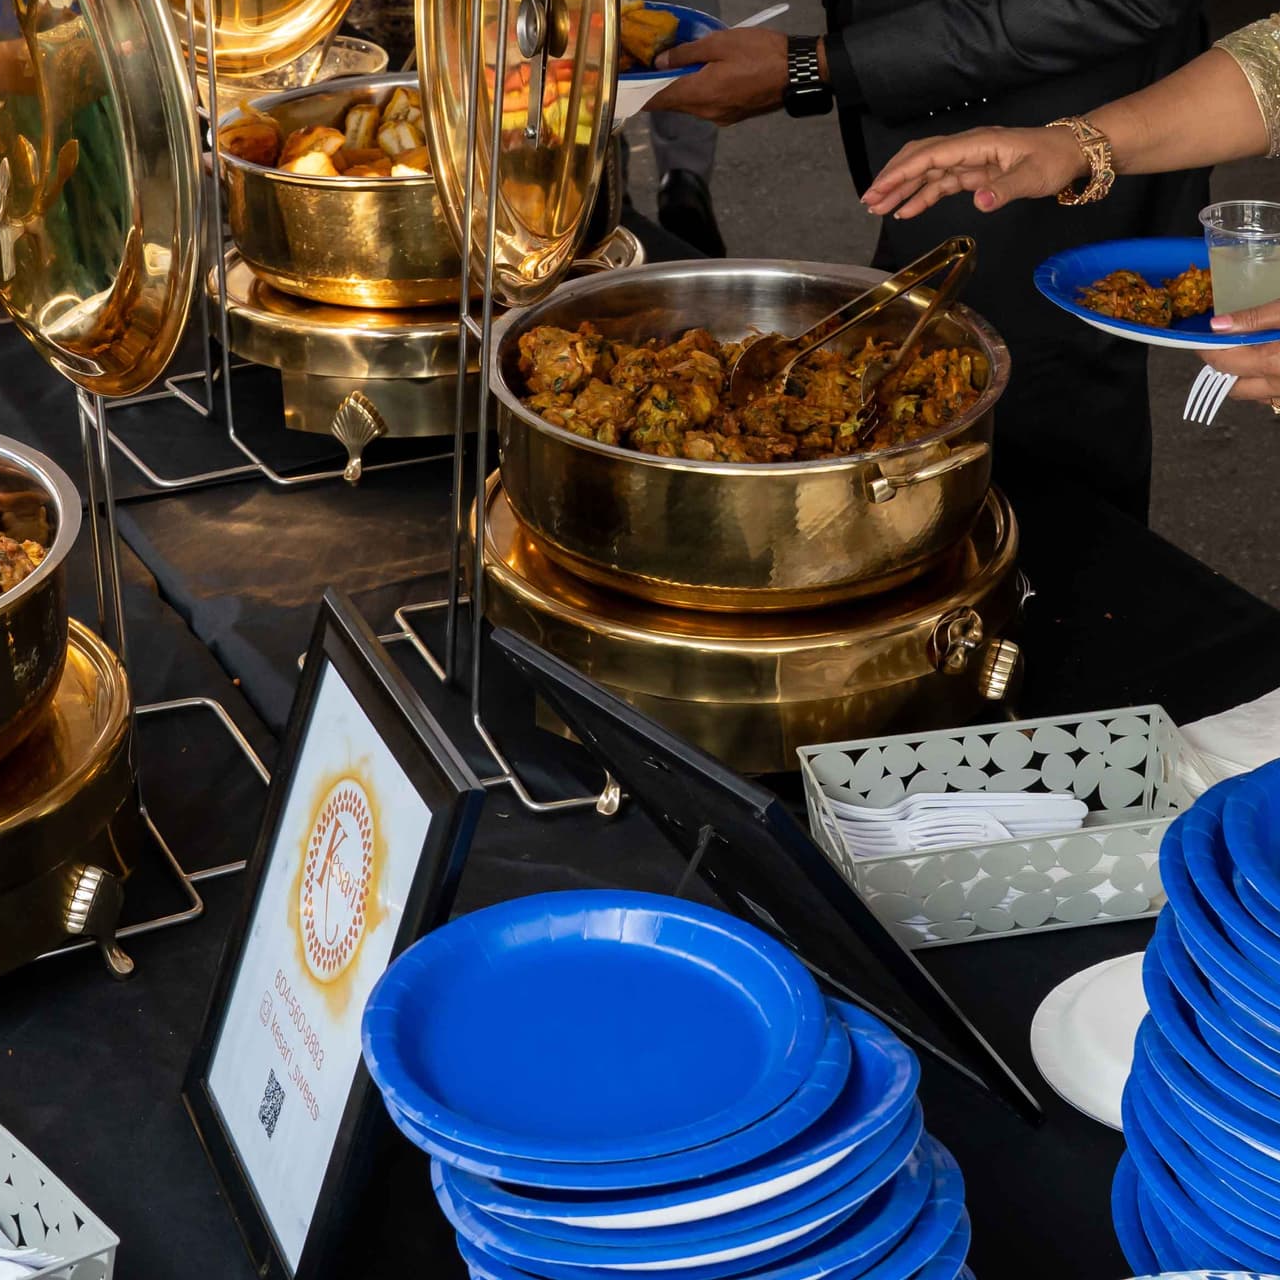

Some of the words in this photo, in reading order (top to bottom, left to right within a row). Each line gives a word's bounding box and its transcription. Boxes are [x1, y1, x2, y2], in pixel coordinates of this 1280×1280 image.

[316, 816, 360, 946] Kesari
[270, 1013, 320, 1121] kesari_sweets
[274, 969, 324, 1071] 604-560-9893
